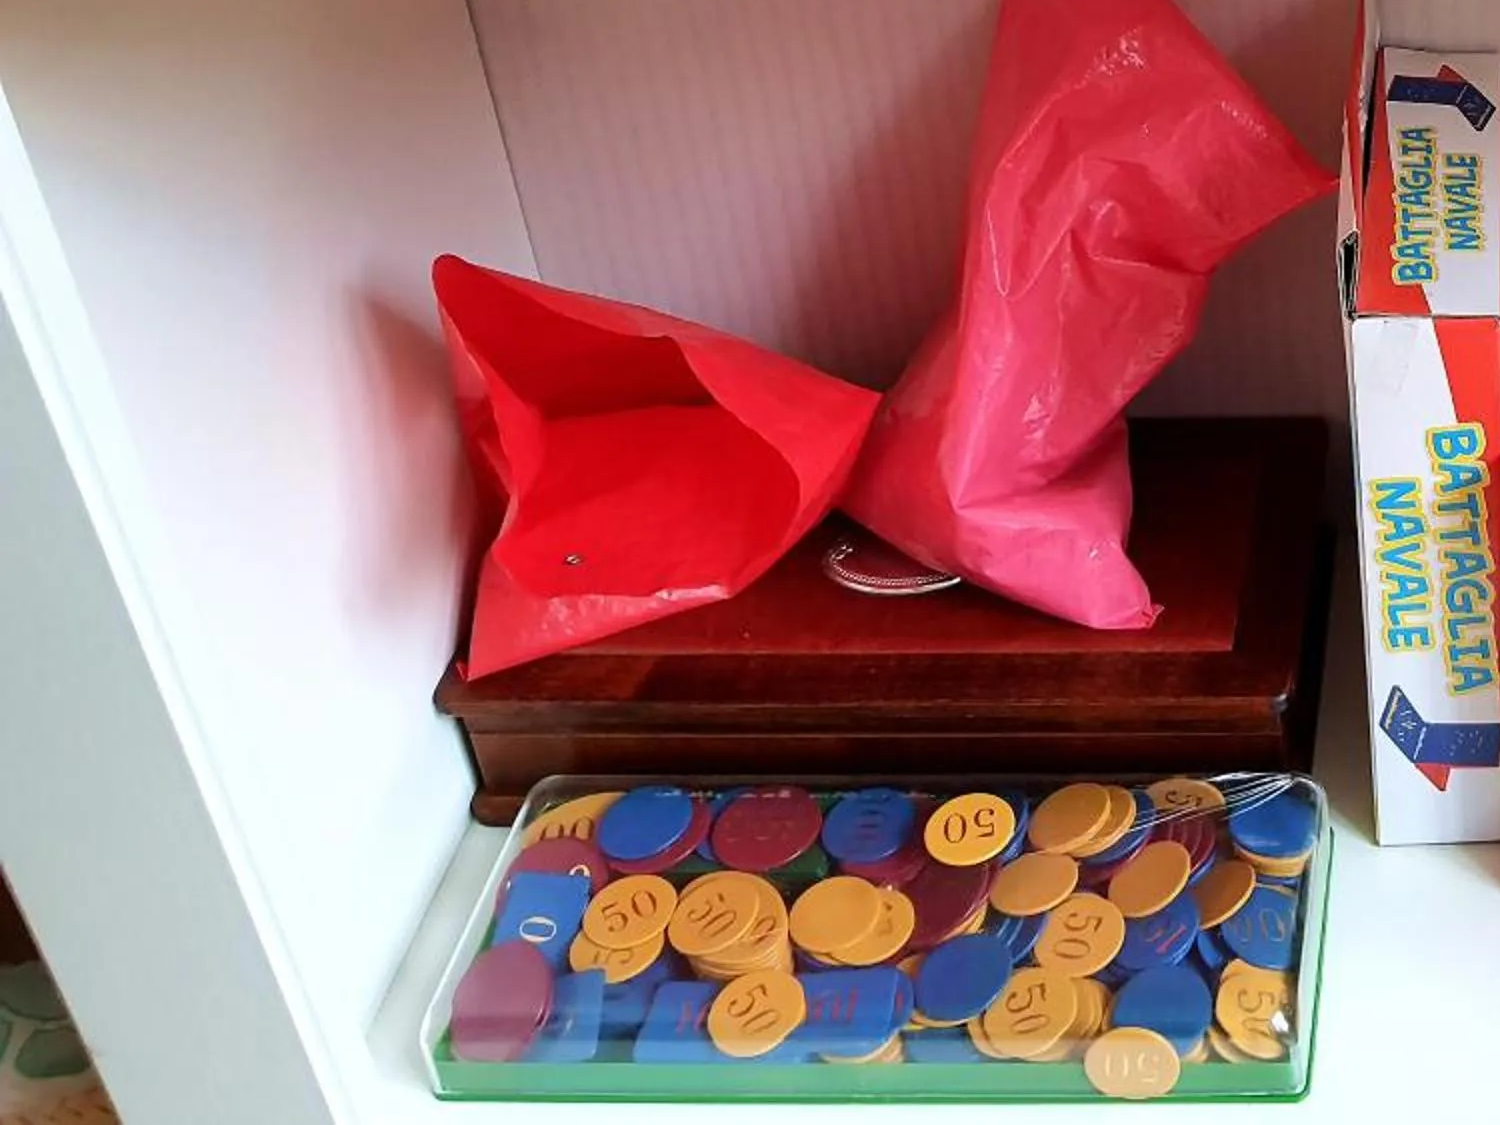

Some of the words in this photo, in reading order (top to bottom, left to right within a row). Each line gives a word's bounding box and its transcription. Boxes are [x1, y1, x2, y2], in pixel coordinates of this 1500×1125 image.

[1393, 127, 1436, 284] BATTAGLIA
[1441, 153, 1484, 250] NAVALE
[1370, 477, 1435, 652] NAVALE
[1427, 423, 1499, 695] BATTAGLIA
[943, 807, 996, 845] 50
[601, 888, 658, 933] 50
[687, 891, 738, 938] 50
[1052, 912, 1103, 960] 50
[726, 982, 782, 1035] 50
[1005, 981, 1048, 1035] 50
[1105, 1051, 1161, 1083] 50
